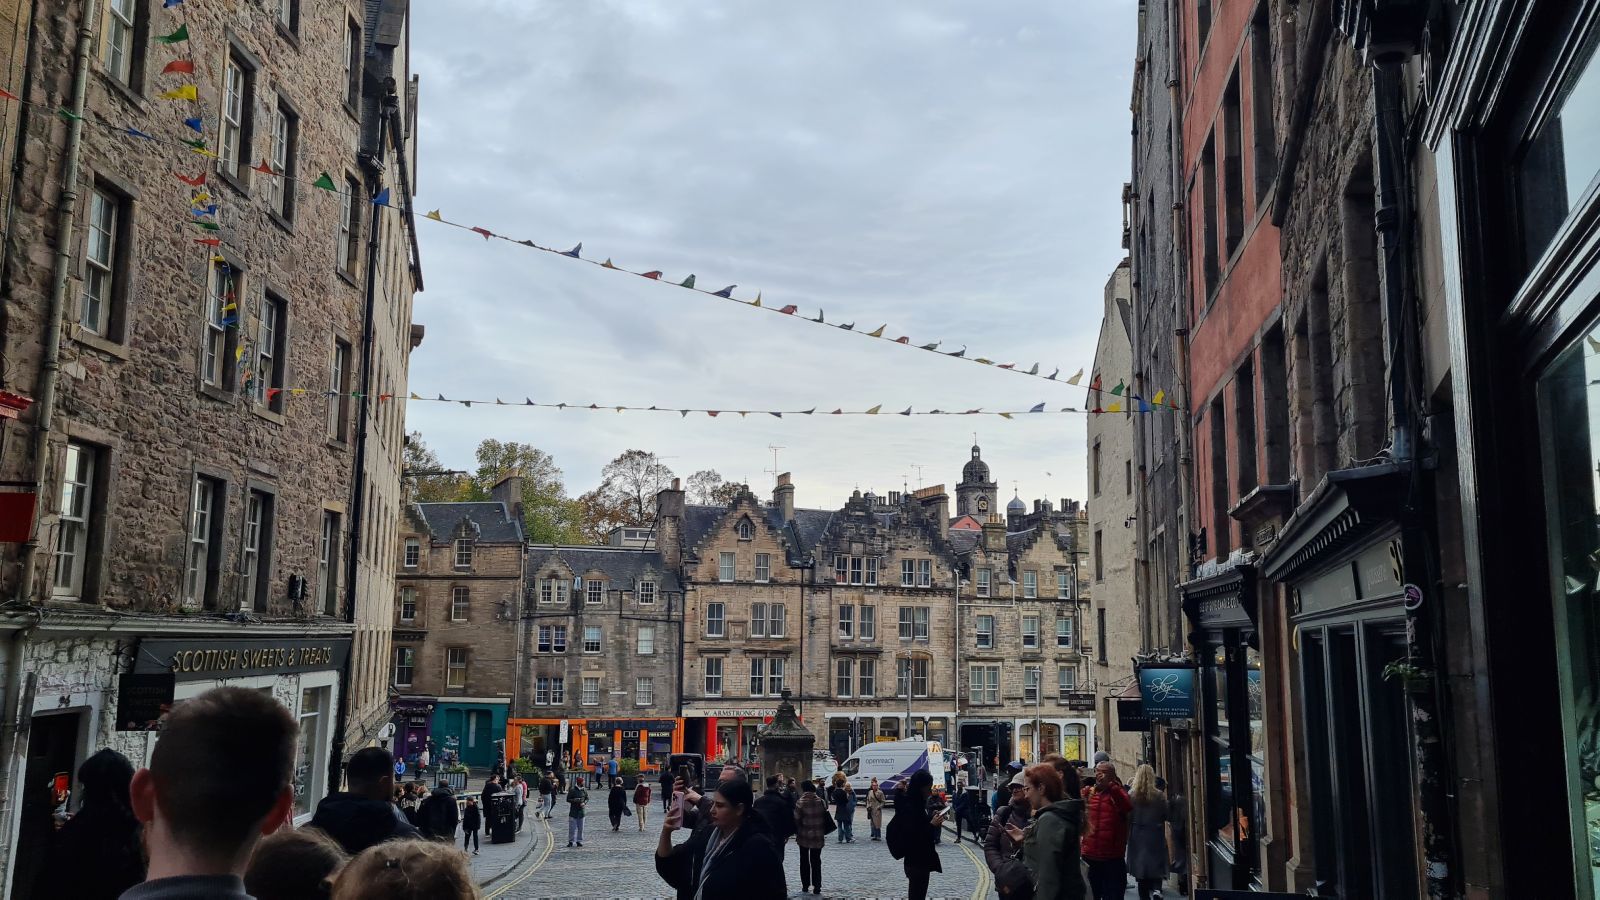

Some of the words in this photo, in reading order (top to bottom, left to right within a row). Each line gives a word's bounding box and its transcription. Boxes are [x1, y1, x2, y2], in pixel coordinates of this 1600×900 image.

[172, 649, 239, 672] SCOTTISH
[241, 647, 286, 669] SWEETS
[287, 648, 296, 666] &
[298, 646, 332, 666] TREATS
